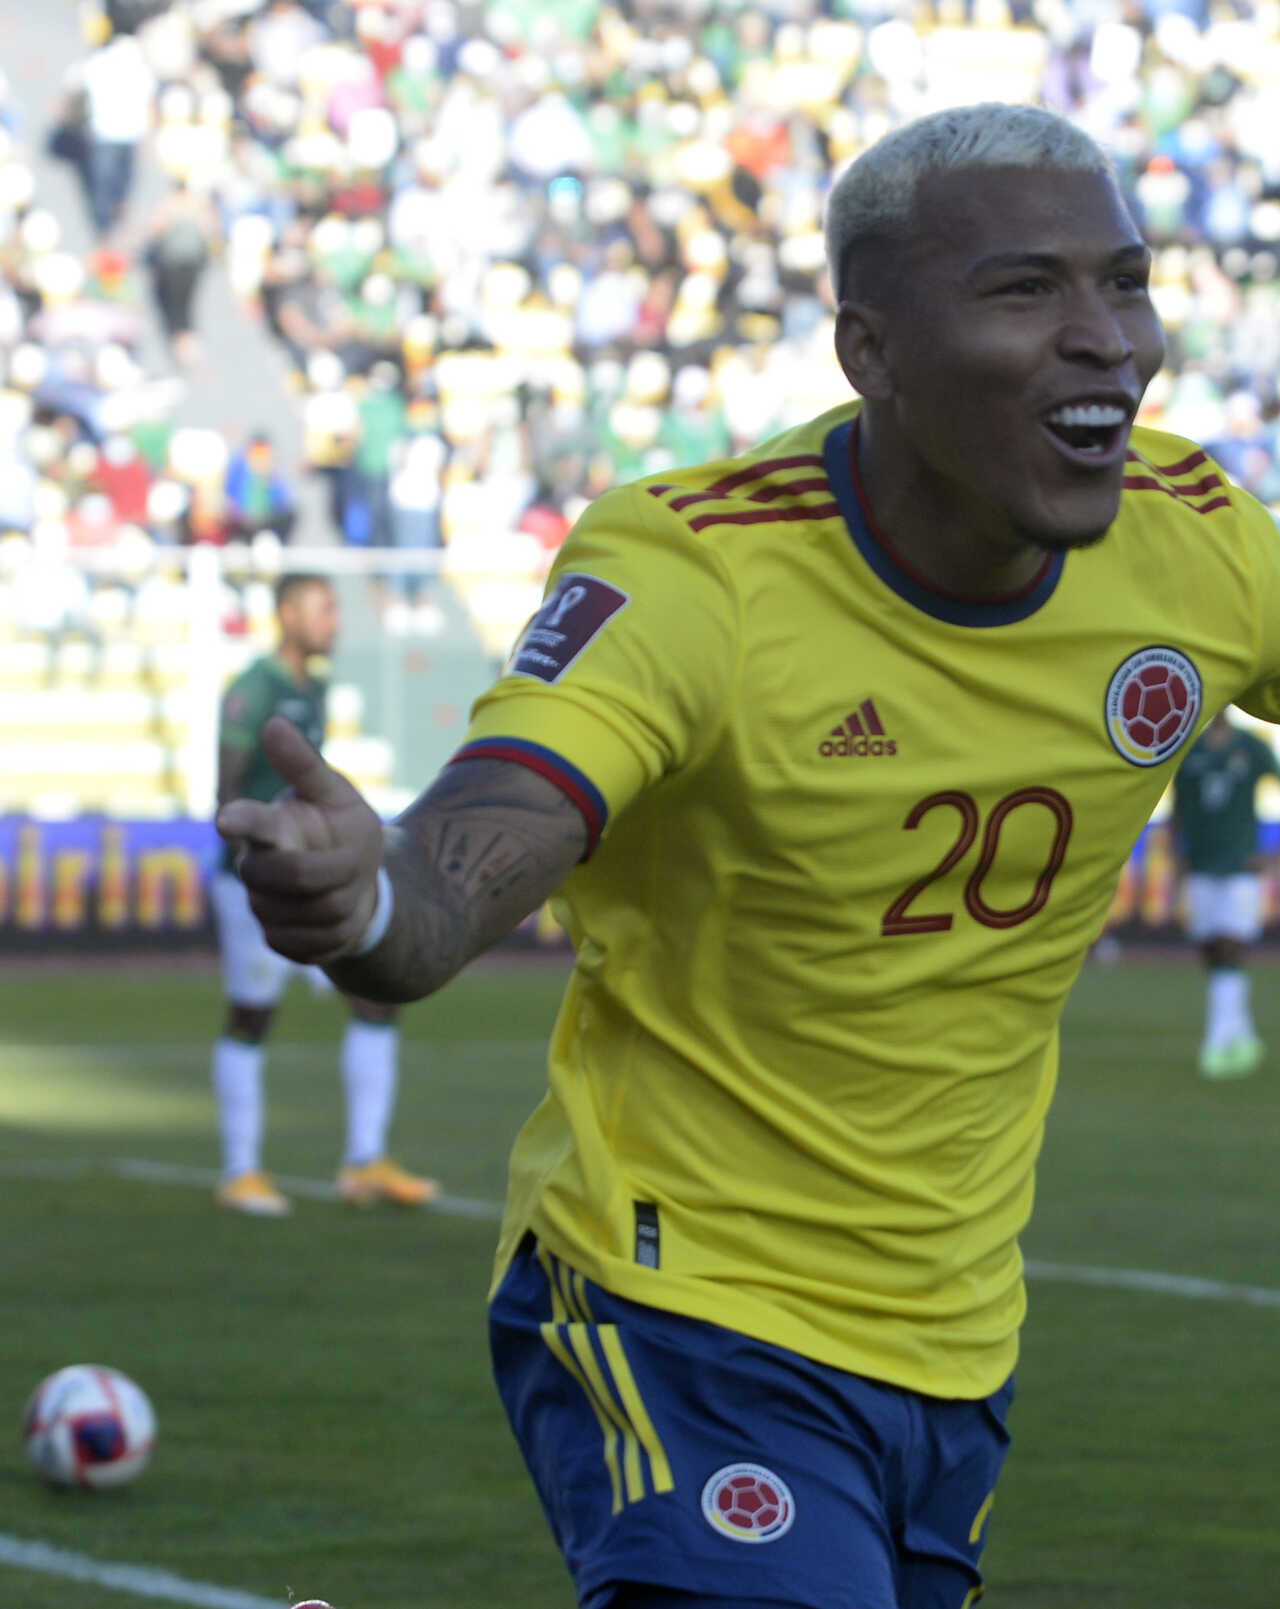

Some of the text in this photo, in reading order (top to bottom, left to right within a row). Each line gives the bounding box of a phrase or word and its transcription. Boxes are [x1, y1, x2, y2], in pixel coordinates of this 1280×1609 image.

[819, 736, 897, 757] adidas
[0, 821, 203, 929] irin
[881, 787, 1073, 936] 20
